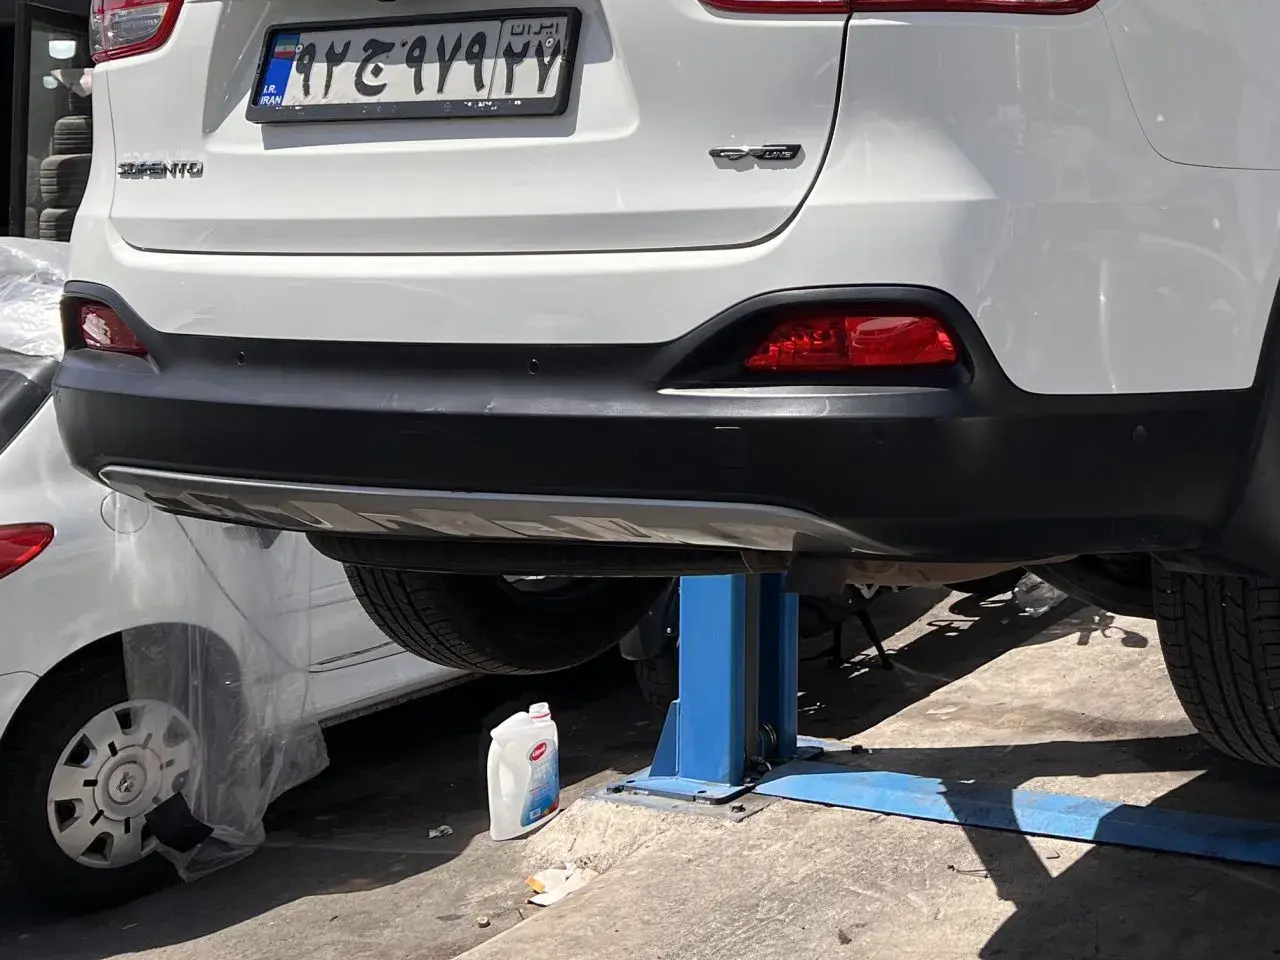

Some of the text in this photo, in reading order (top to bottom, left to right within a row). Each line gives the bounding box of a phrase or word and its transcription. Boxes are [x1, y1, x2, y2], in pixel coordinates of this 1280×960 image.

[511, 21, 559, 36] ایران
[263, 84, 276, 93] I.R.
[260, 95, 282, 105] IRAN
